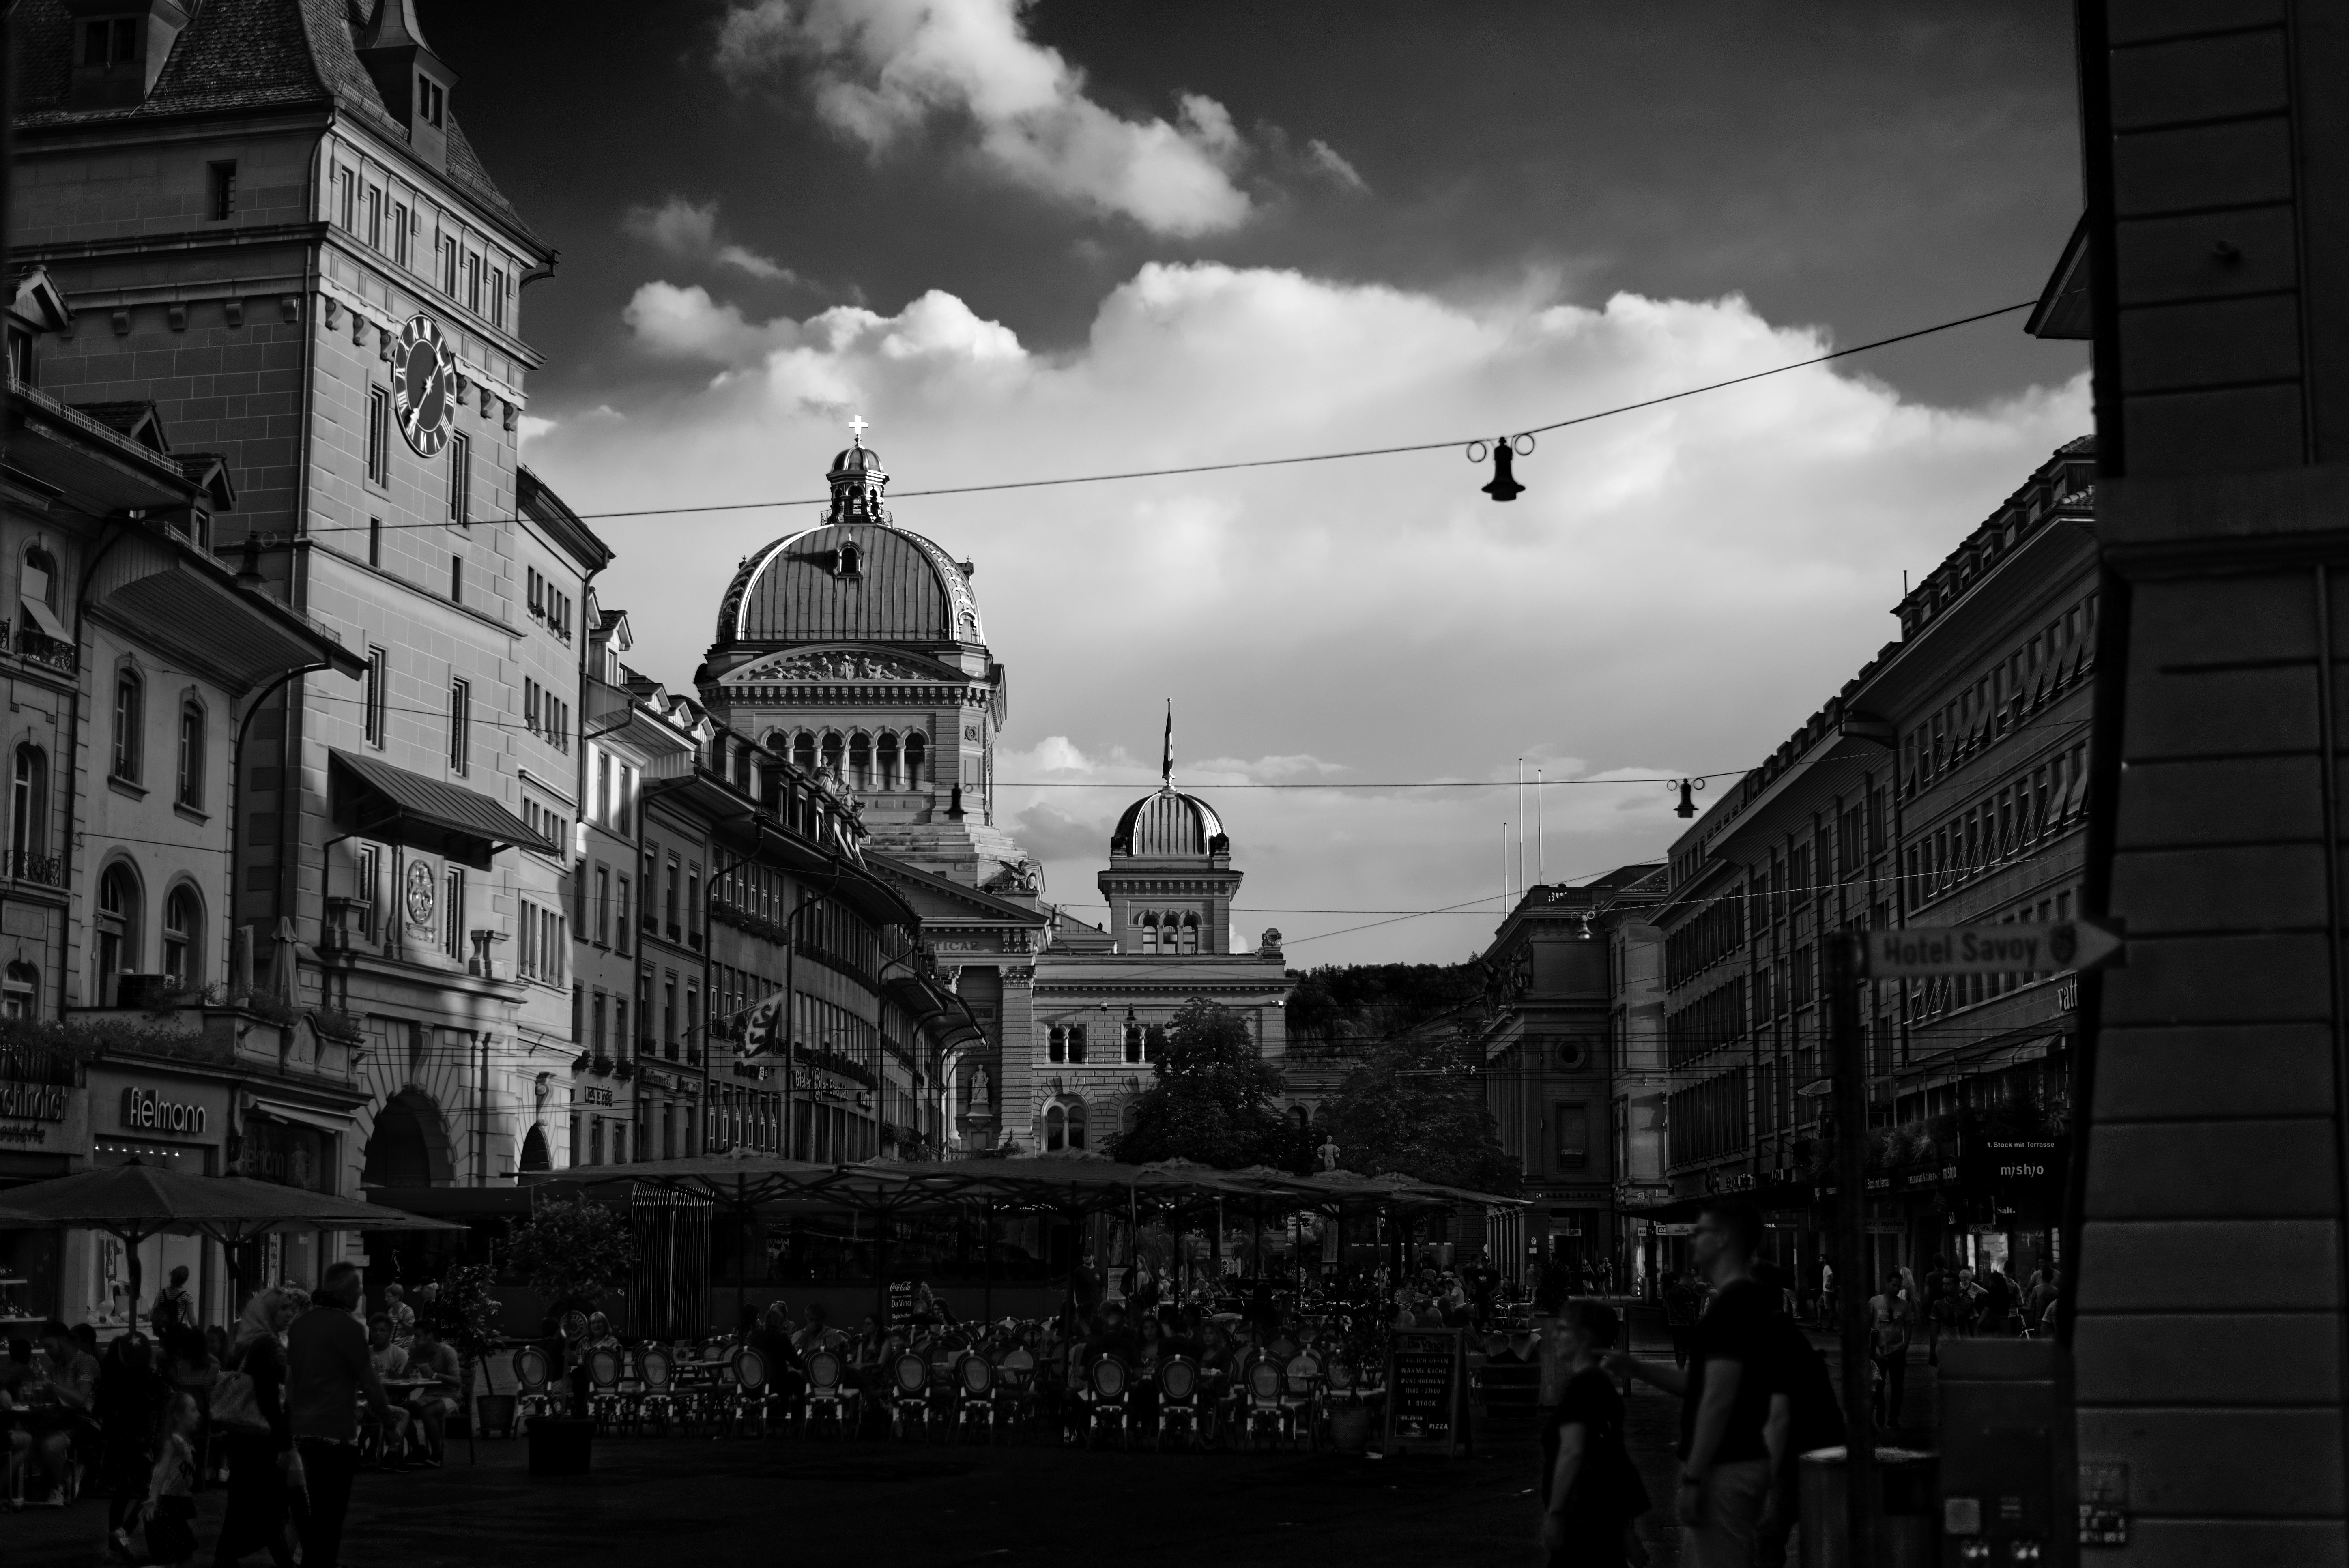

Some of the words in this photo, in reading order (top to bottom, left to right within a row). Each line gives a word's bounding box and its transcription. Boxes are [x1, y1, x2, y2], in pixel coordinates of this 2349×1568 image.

[934, 941, 979, 950] TICAE
[1884, 935, 1952, 964] Hotel
[1962, 932, 2038, 966] Savoy
[2058, 974, 2078, 1011] vatt
[795, 1070, 811, 1090] Gfeller
[823, 1082, 829, 1093] am
[131, 1087, 206, 1133] fielmann
[891, 1300, 898, 1308] Da
[899, 1299, 911, 1307] Vinci
[1421, 1340, 1444, 1349] Vinci
